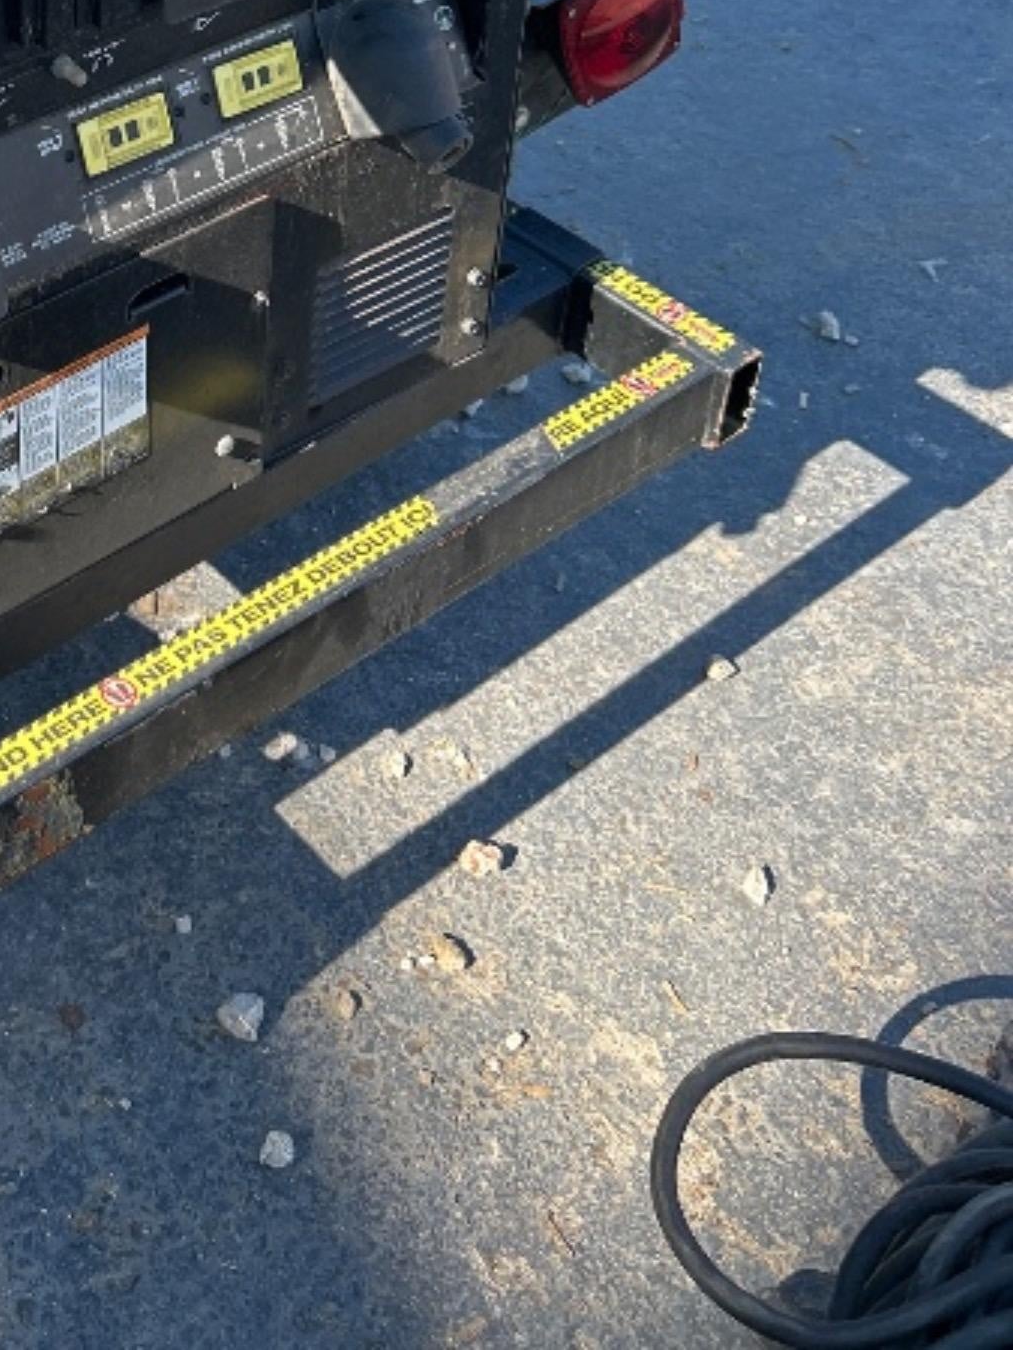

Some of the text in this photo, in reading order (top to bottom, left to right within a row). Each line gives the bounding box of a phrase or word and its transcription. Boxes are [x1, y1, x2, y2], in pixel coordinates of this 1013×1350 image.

[29, 699, 103, 751] HERE
[135, 656, 177, 688] NE
[172, 628, 228, 667] PAS
[229, 581, 309, 631] TENEZ
[305, 523, 403, 585] DEBOUT
